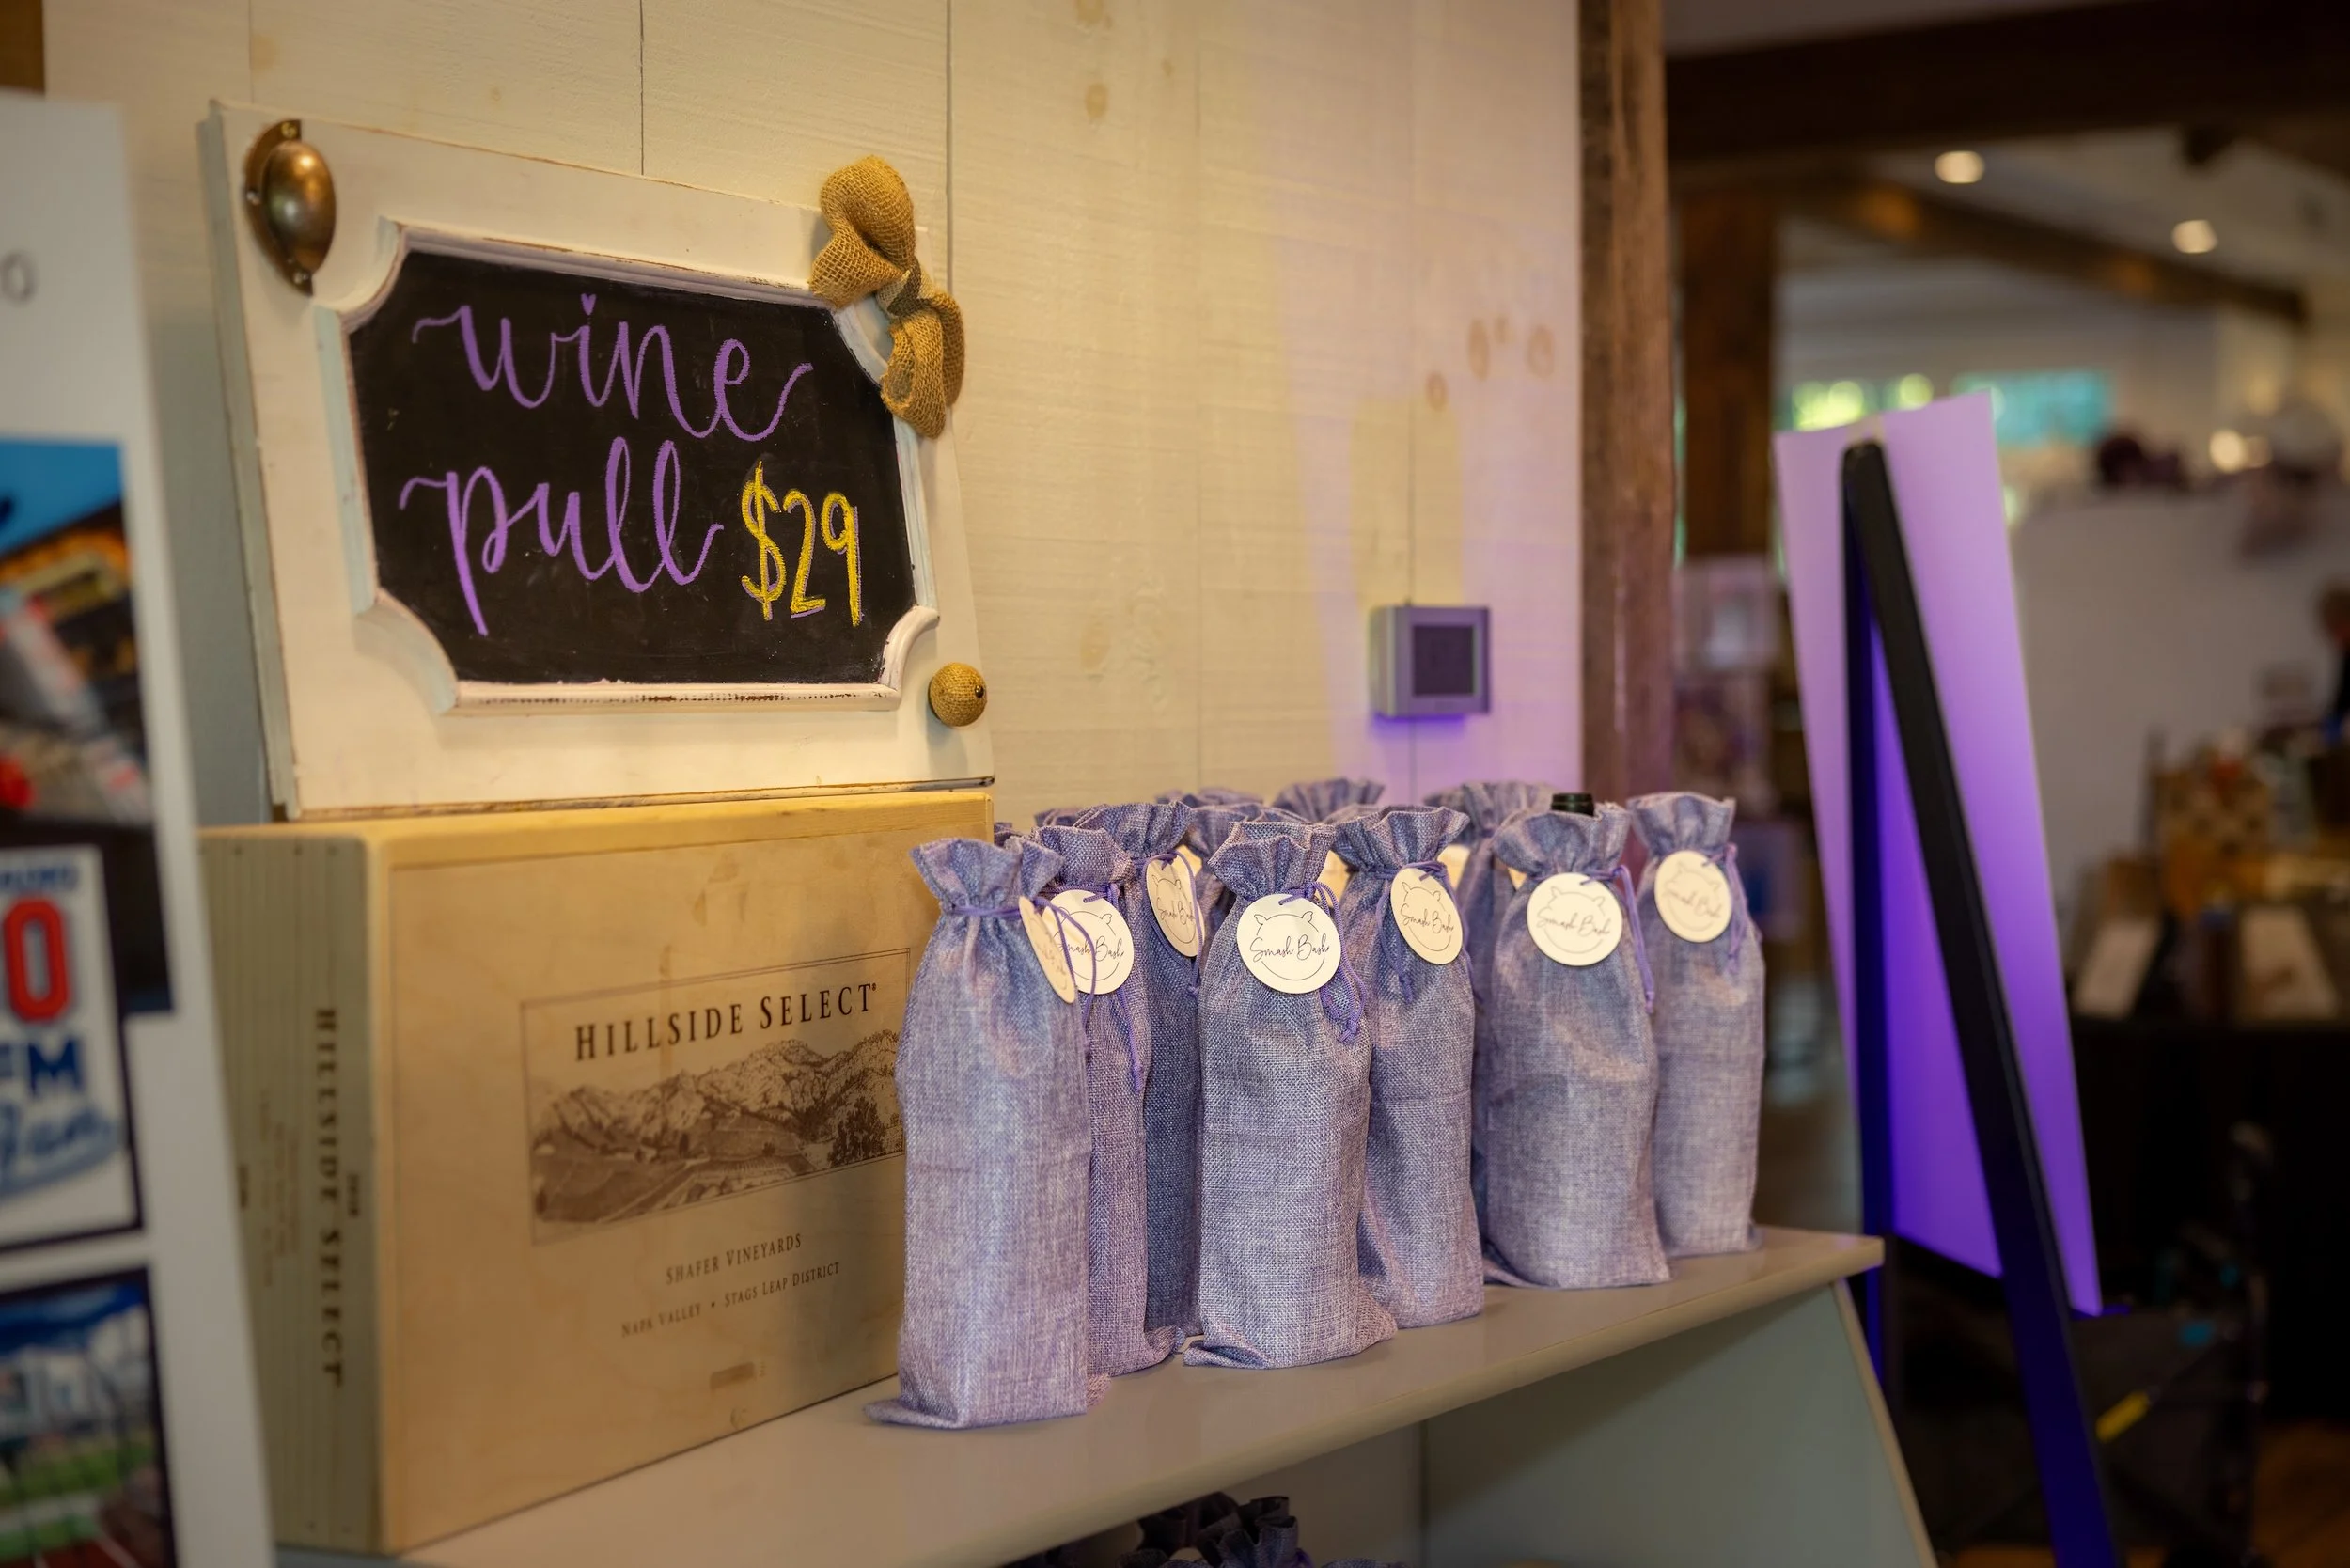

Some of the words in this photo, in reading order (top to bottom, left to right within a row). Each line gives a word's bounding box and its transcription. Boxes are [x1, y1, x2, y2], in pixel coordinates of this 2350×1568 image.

[412, 293, 813, 442] wine
[399, 436, 724, 636] pull
[741, 461, 863, 627] $29
[1094, 935, 1125, 962] Bash
[1249, 935, 1294, 963] Smash
[1297, 933, 1330, 961] Bash
[1401, 902, 1431, 926] Smash
[575, 1002, 743, 1061] HILLSIDE
[315, 1007, 340, 1204] HILLSIDE
[665, 1255, 720, 1286] SHAFER
[725, 1232, 803, 1268] VINEYARDS
[319, 1227, 345, 1390] SELECT
[620, 1318, 653, 1339] NAPA
[658, 1302, 702, 1327] VALLEY
[724, 1287, 758, 1308] STAGS
[761, 1277, 788, 1296] LEAP
[791, 1262, 840, 1287] DISTRICT
